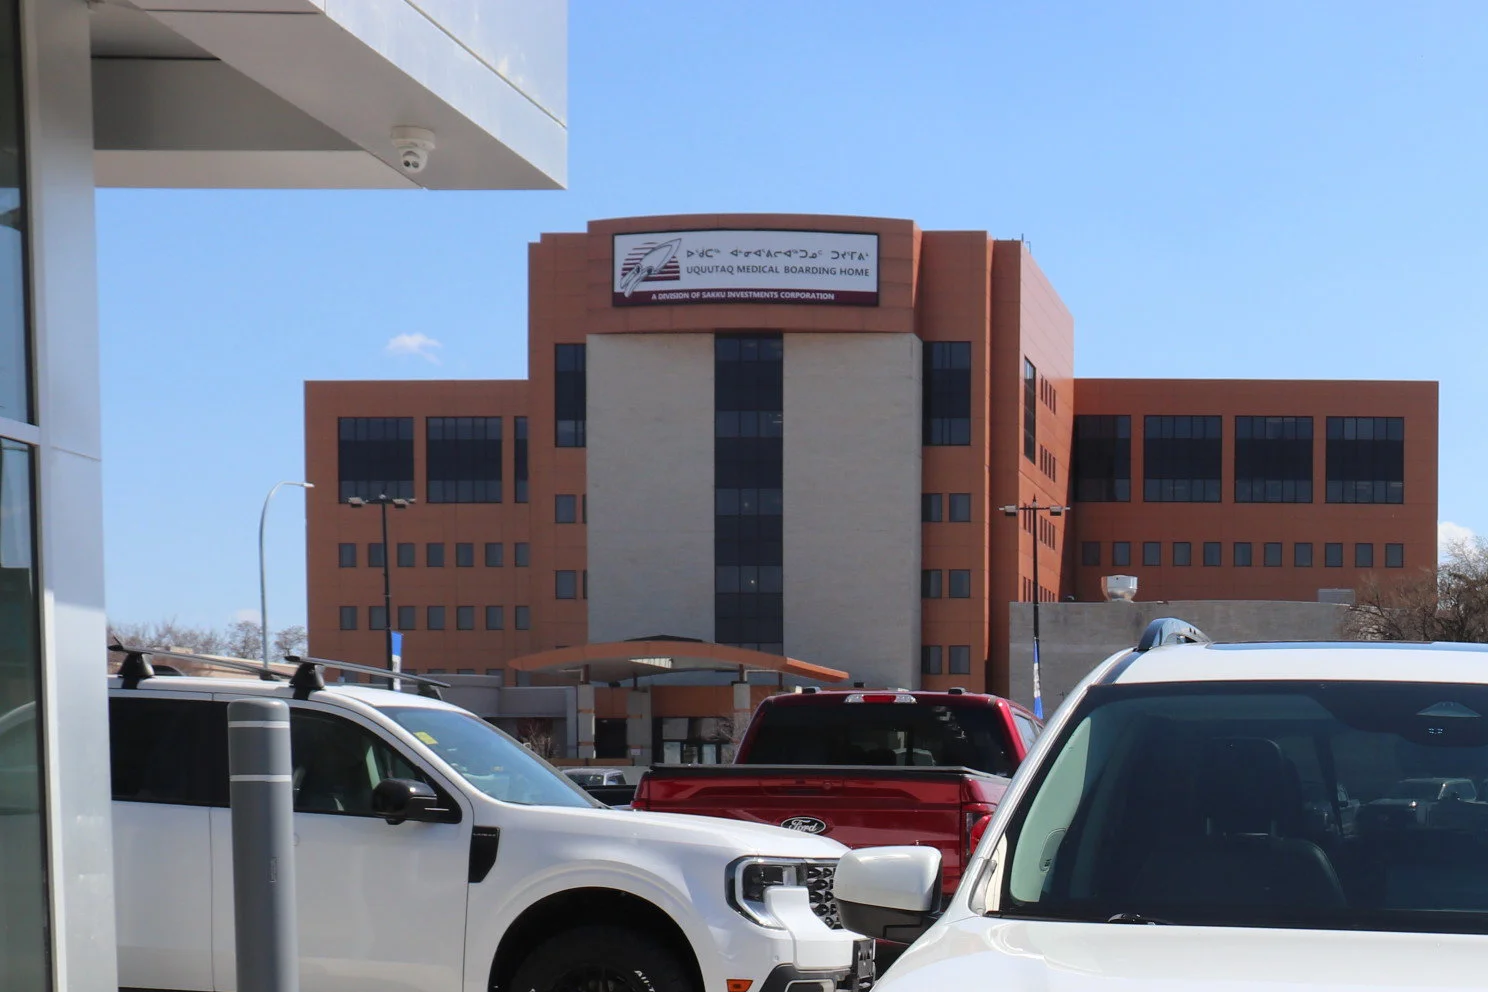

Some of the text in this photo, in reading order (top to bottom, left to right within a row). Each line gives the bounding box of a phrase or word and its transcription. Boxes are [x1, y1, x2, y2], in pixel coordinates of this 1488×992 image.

[686, 265, 871, 277] UQUUTAQ MEDICAL BOARDING HOME
[658, 292, 690, 300] DIVISION
[690, 291, 701, 299] OF
[727, 291, 779, 299] INVESTMENTS
[779, 291, 835, 301] CORPORATION
[788, 818, 818, 832] Ford
